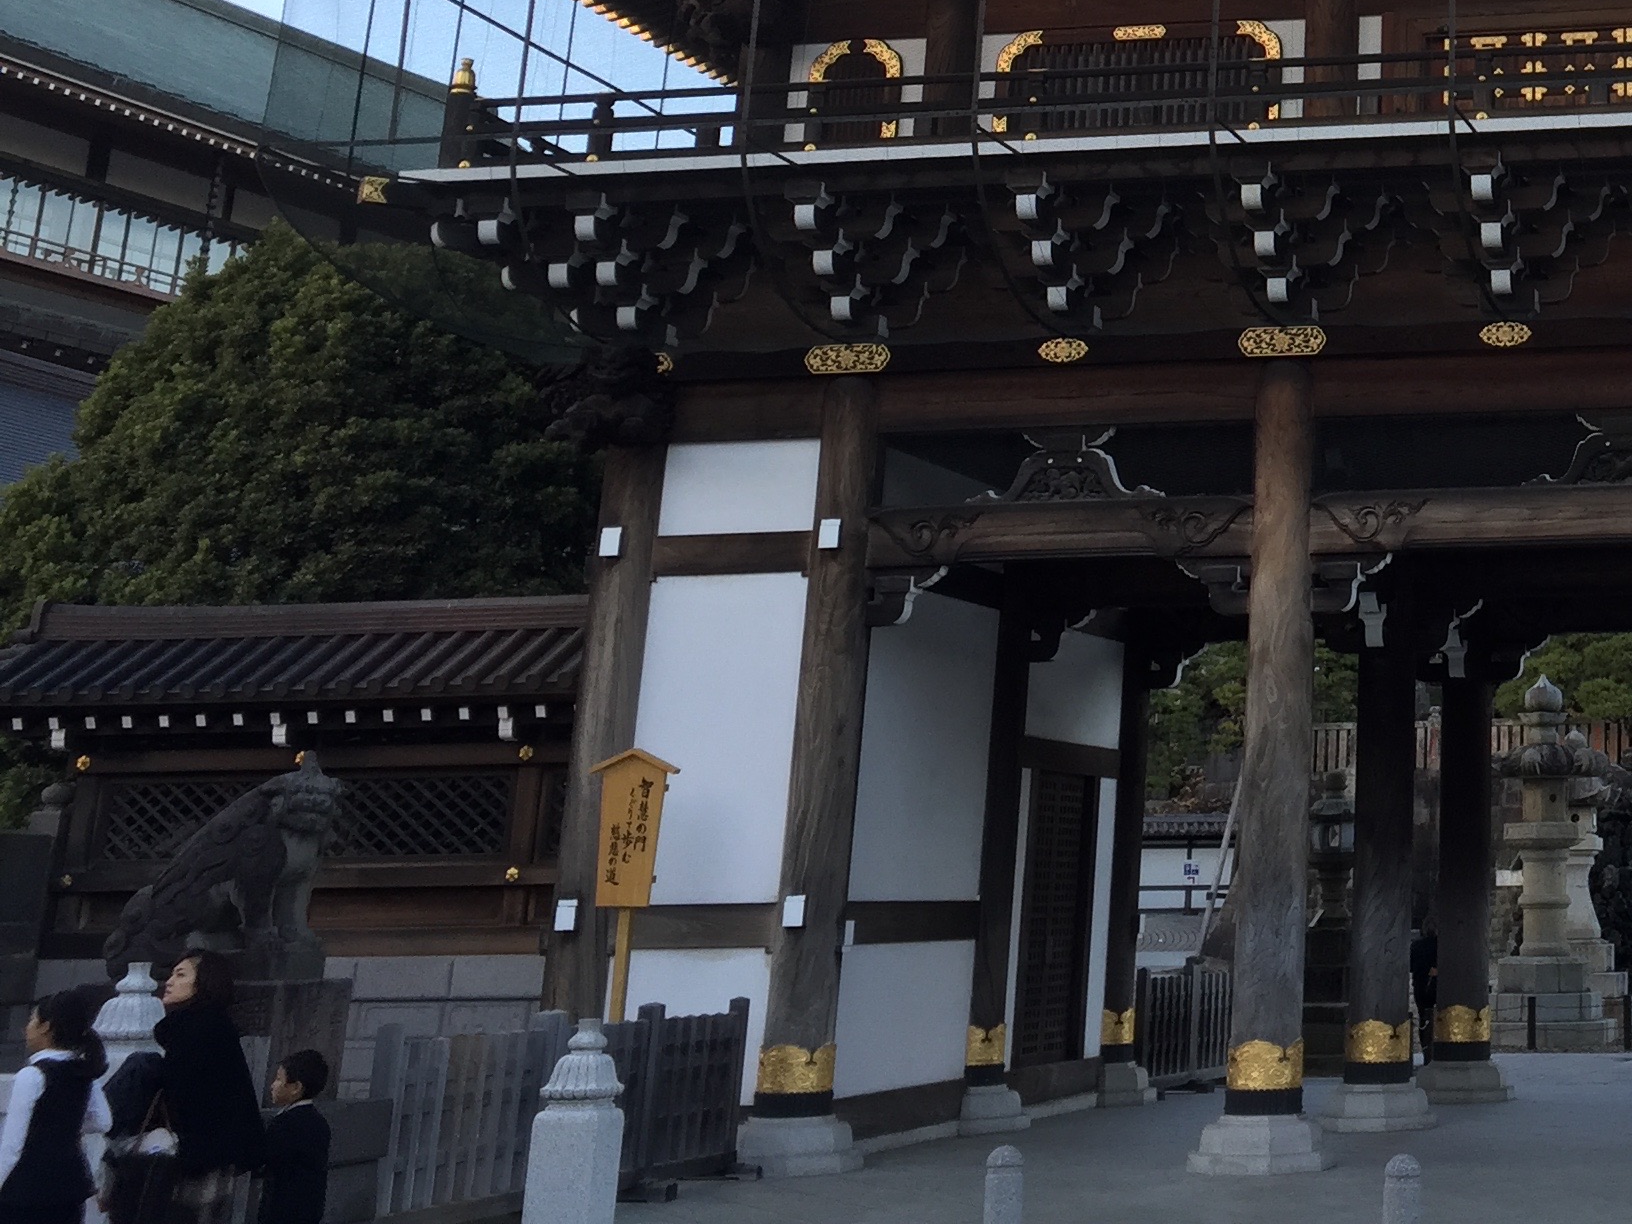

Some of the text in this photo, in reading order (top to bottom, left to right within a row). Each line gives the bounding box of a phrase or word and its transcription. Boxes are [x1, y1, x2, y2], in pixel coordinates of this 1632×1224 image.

[634, 778, 654, 852] 智慧の門
[605, 824, 620, 885] 慈悲の道
